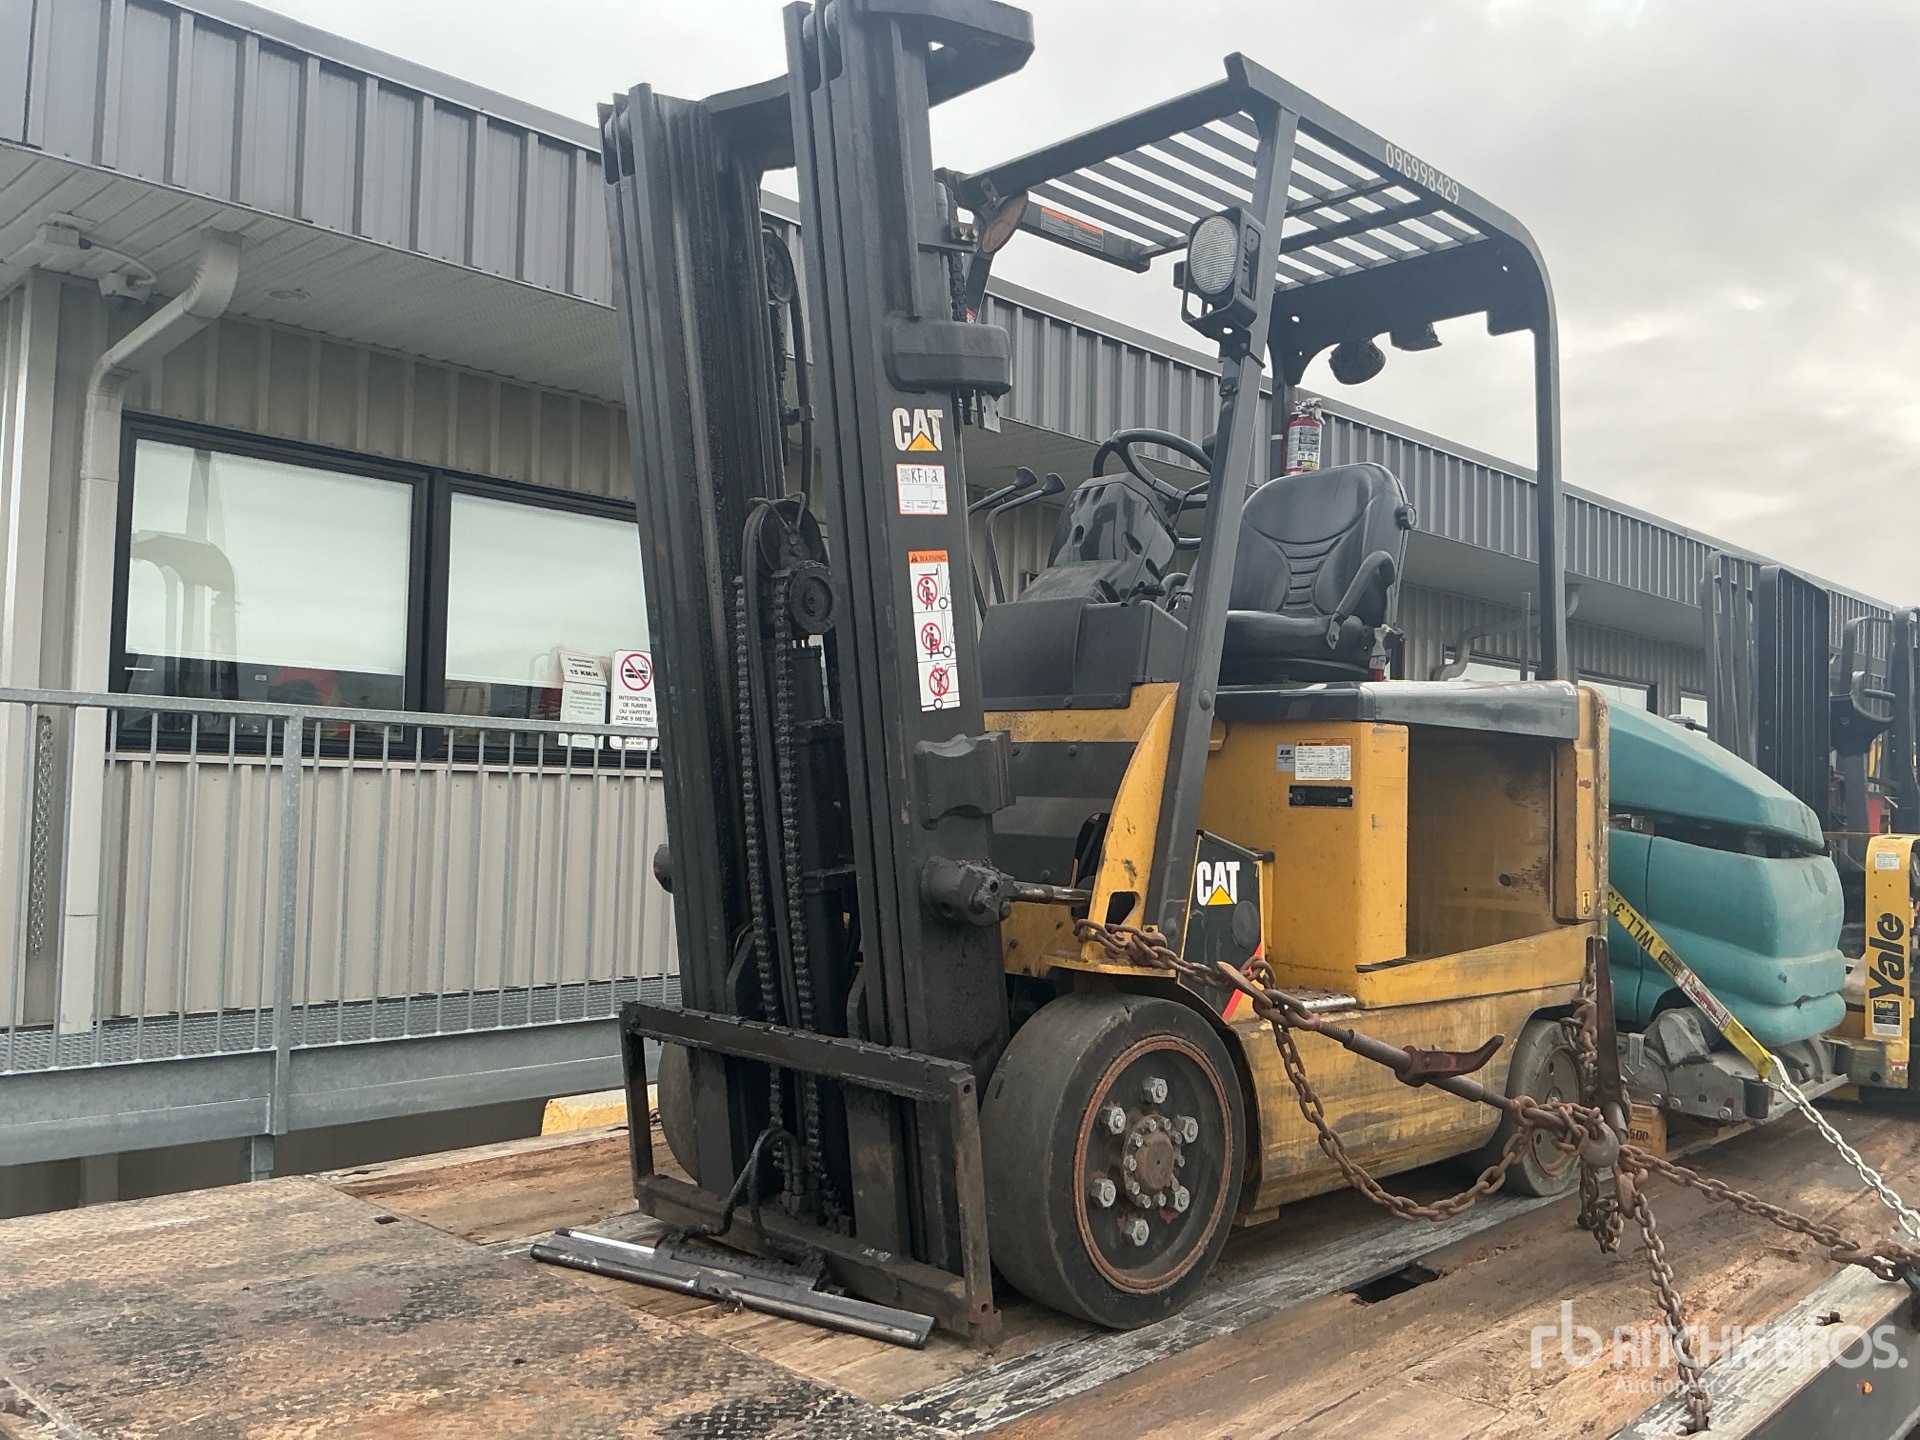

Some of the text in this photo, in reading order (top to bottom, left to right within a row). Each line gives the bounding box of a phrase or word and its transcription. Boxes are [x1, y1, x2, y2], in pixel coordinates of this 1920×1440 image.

[1385, 142, 1460, 205] 09G998429
[892, 407, 943, 452] CAT
[919, 554, 947, 563] WARNING
[1196, 861, 1240, 906] CAT
[1868, 912, 1905, 999] Yale
